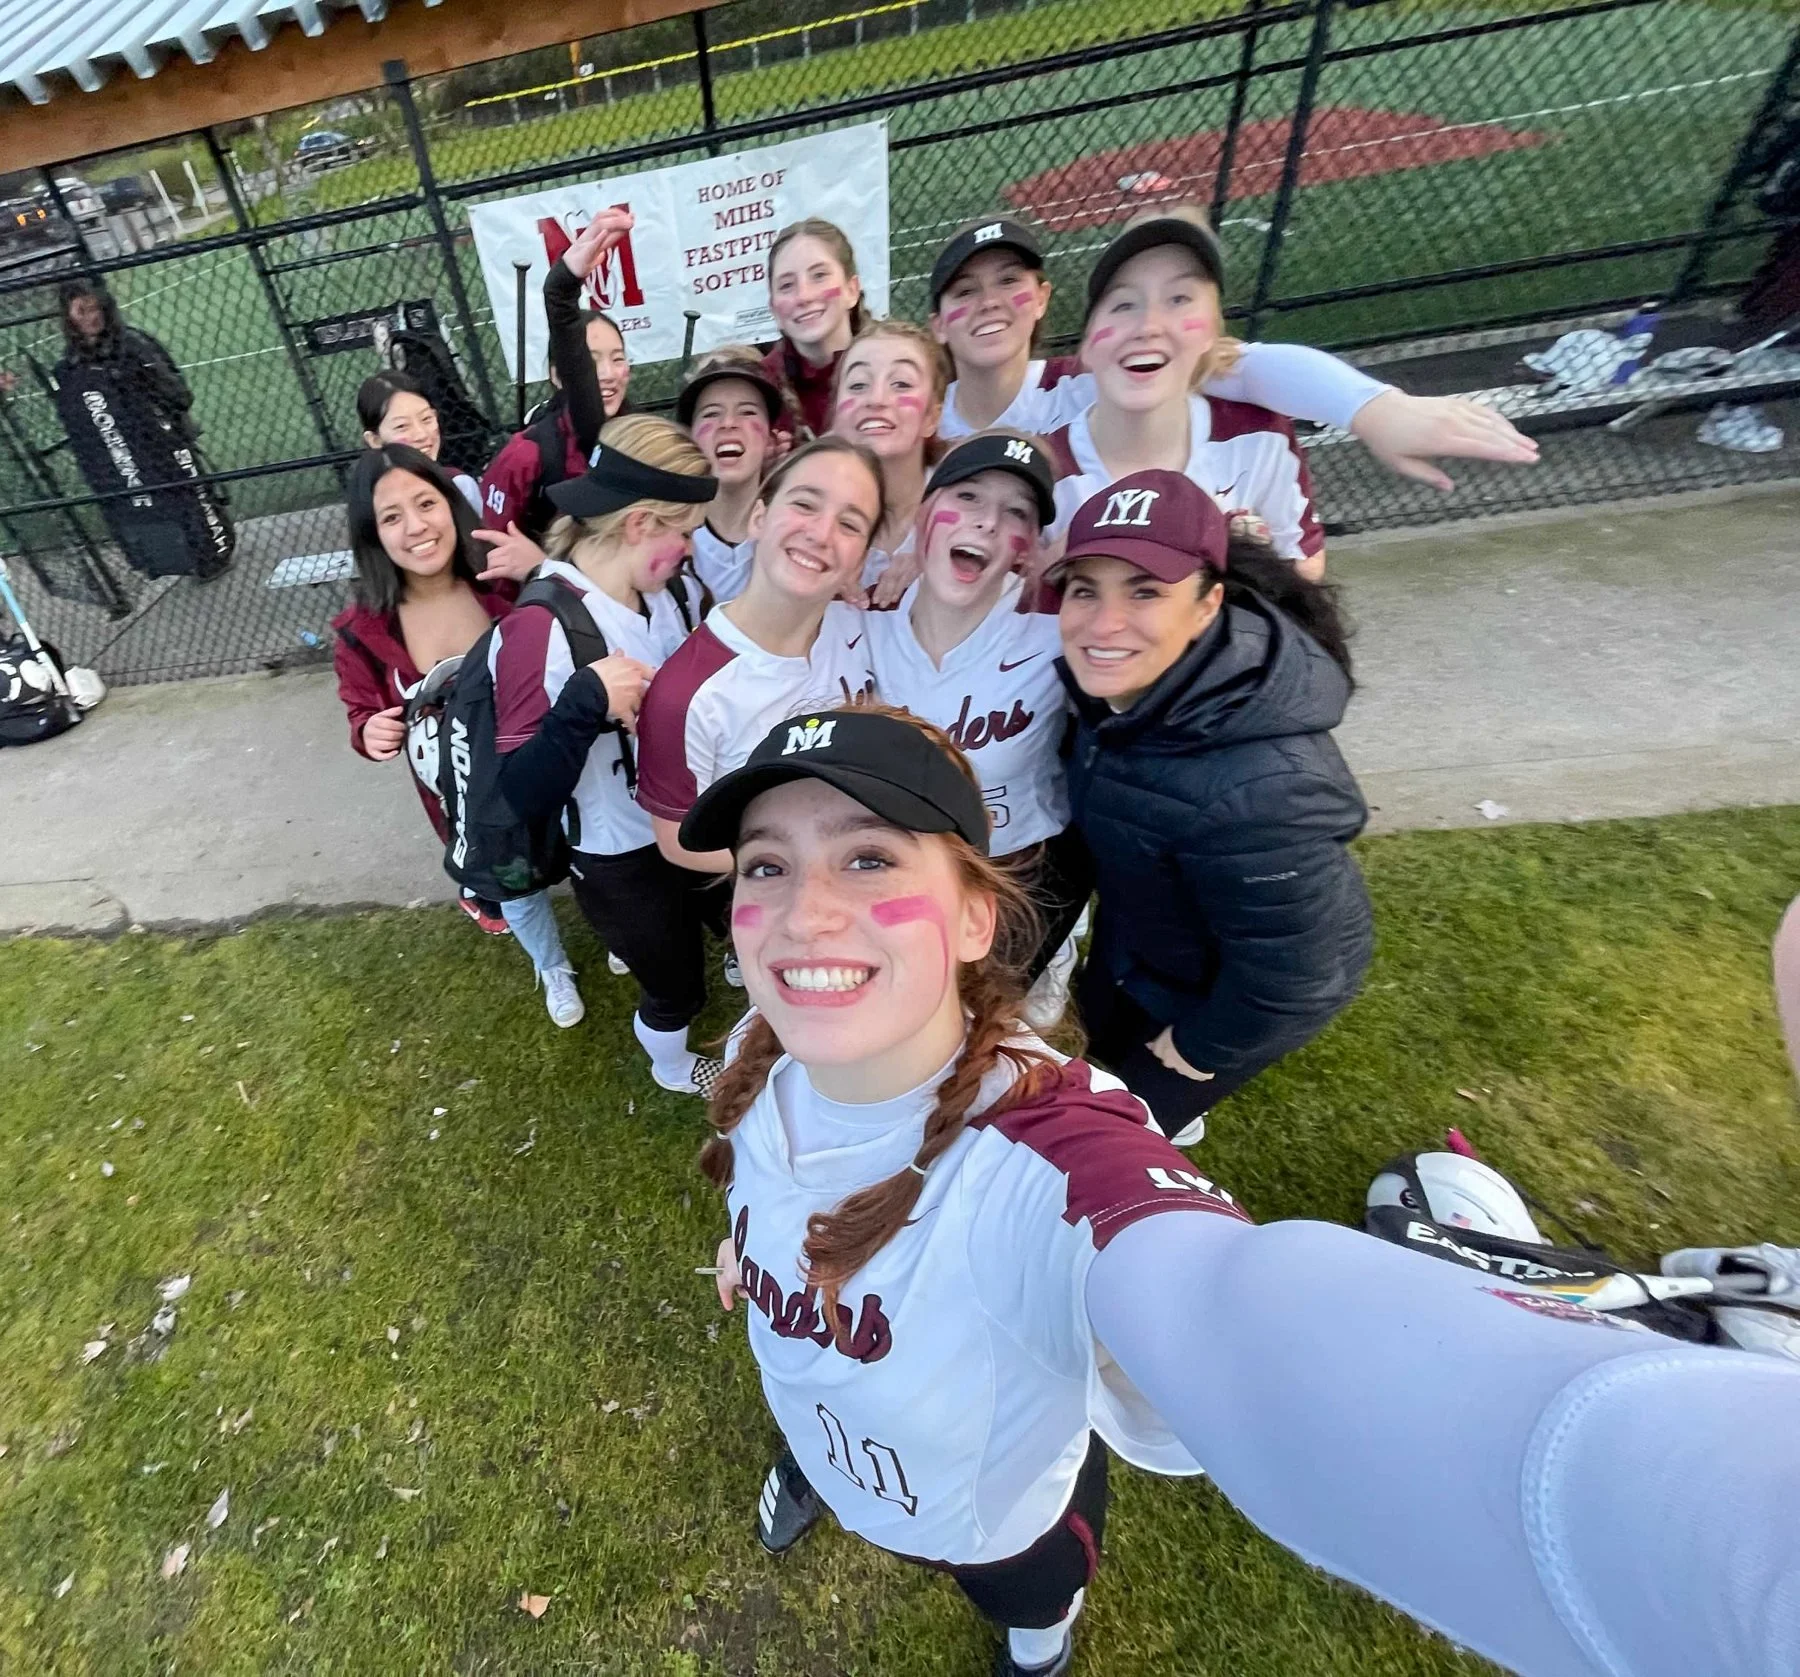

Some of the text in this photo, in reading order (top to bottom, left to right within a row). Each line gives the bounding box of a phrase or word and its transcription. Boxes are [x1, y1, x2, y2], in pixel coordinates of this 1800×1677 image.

[698, 169, 788, 203] HOME OF
[714, 199, 775, 230] MIHS
[684, 230, 777, 268] FASTPIT
[693, 263, 765, 295] SOFTB
[486, 483, 506, 515] 19
[450, 716, 472, 870] EASTON
[816, 1402, 918, 1517] 11
